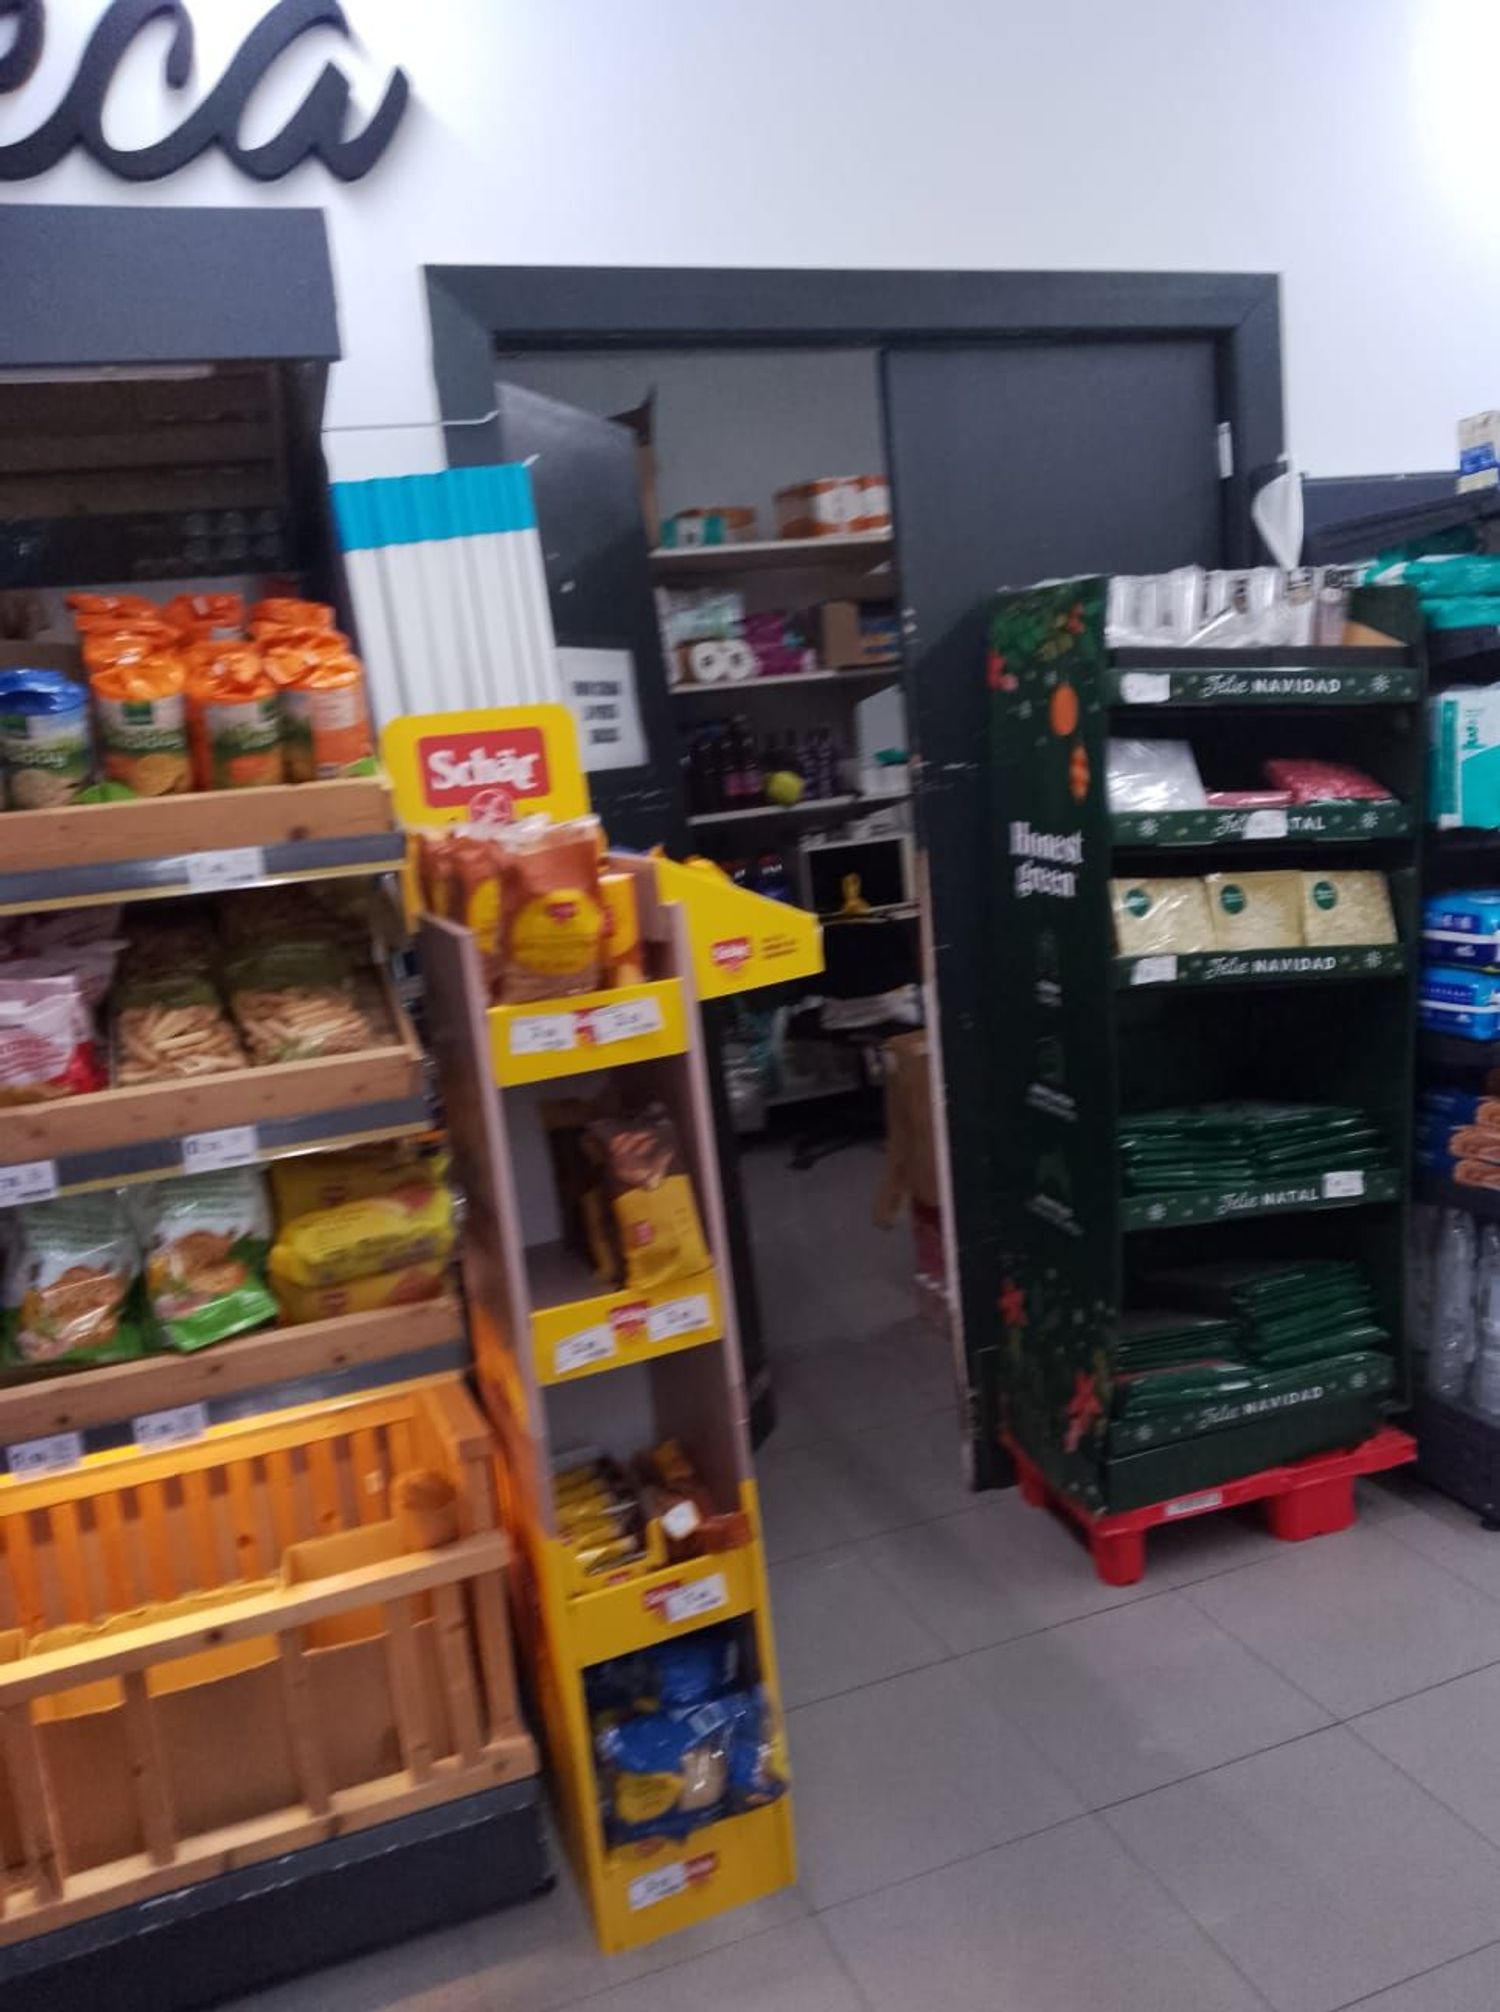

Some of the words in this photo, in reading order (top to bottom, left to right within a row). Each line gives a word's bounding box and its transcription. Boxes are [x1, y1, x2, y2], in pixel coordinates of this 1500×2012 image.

[1253, 677, 1342, 695] NAVIDAD
[1009, 820, 1085, 864] Honest
[1014, 860, 1076, 898] green
[1252, 956, 1337, 974] NAVIDAD
[1263, 1189, 1319, 1206] NATAL
[1242, 1386, 1325, 1416] NAVIDAD
